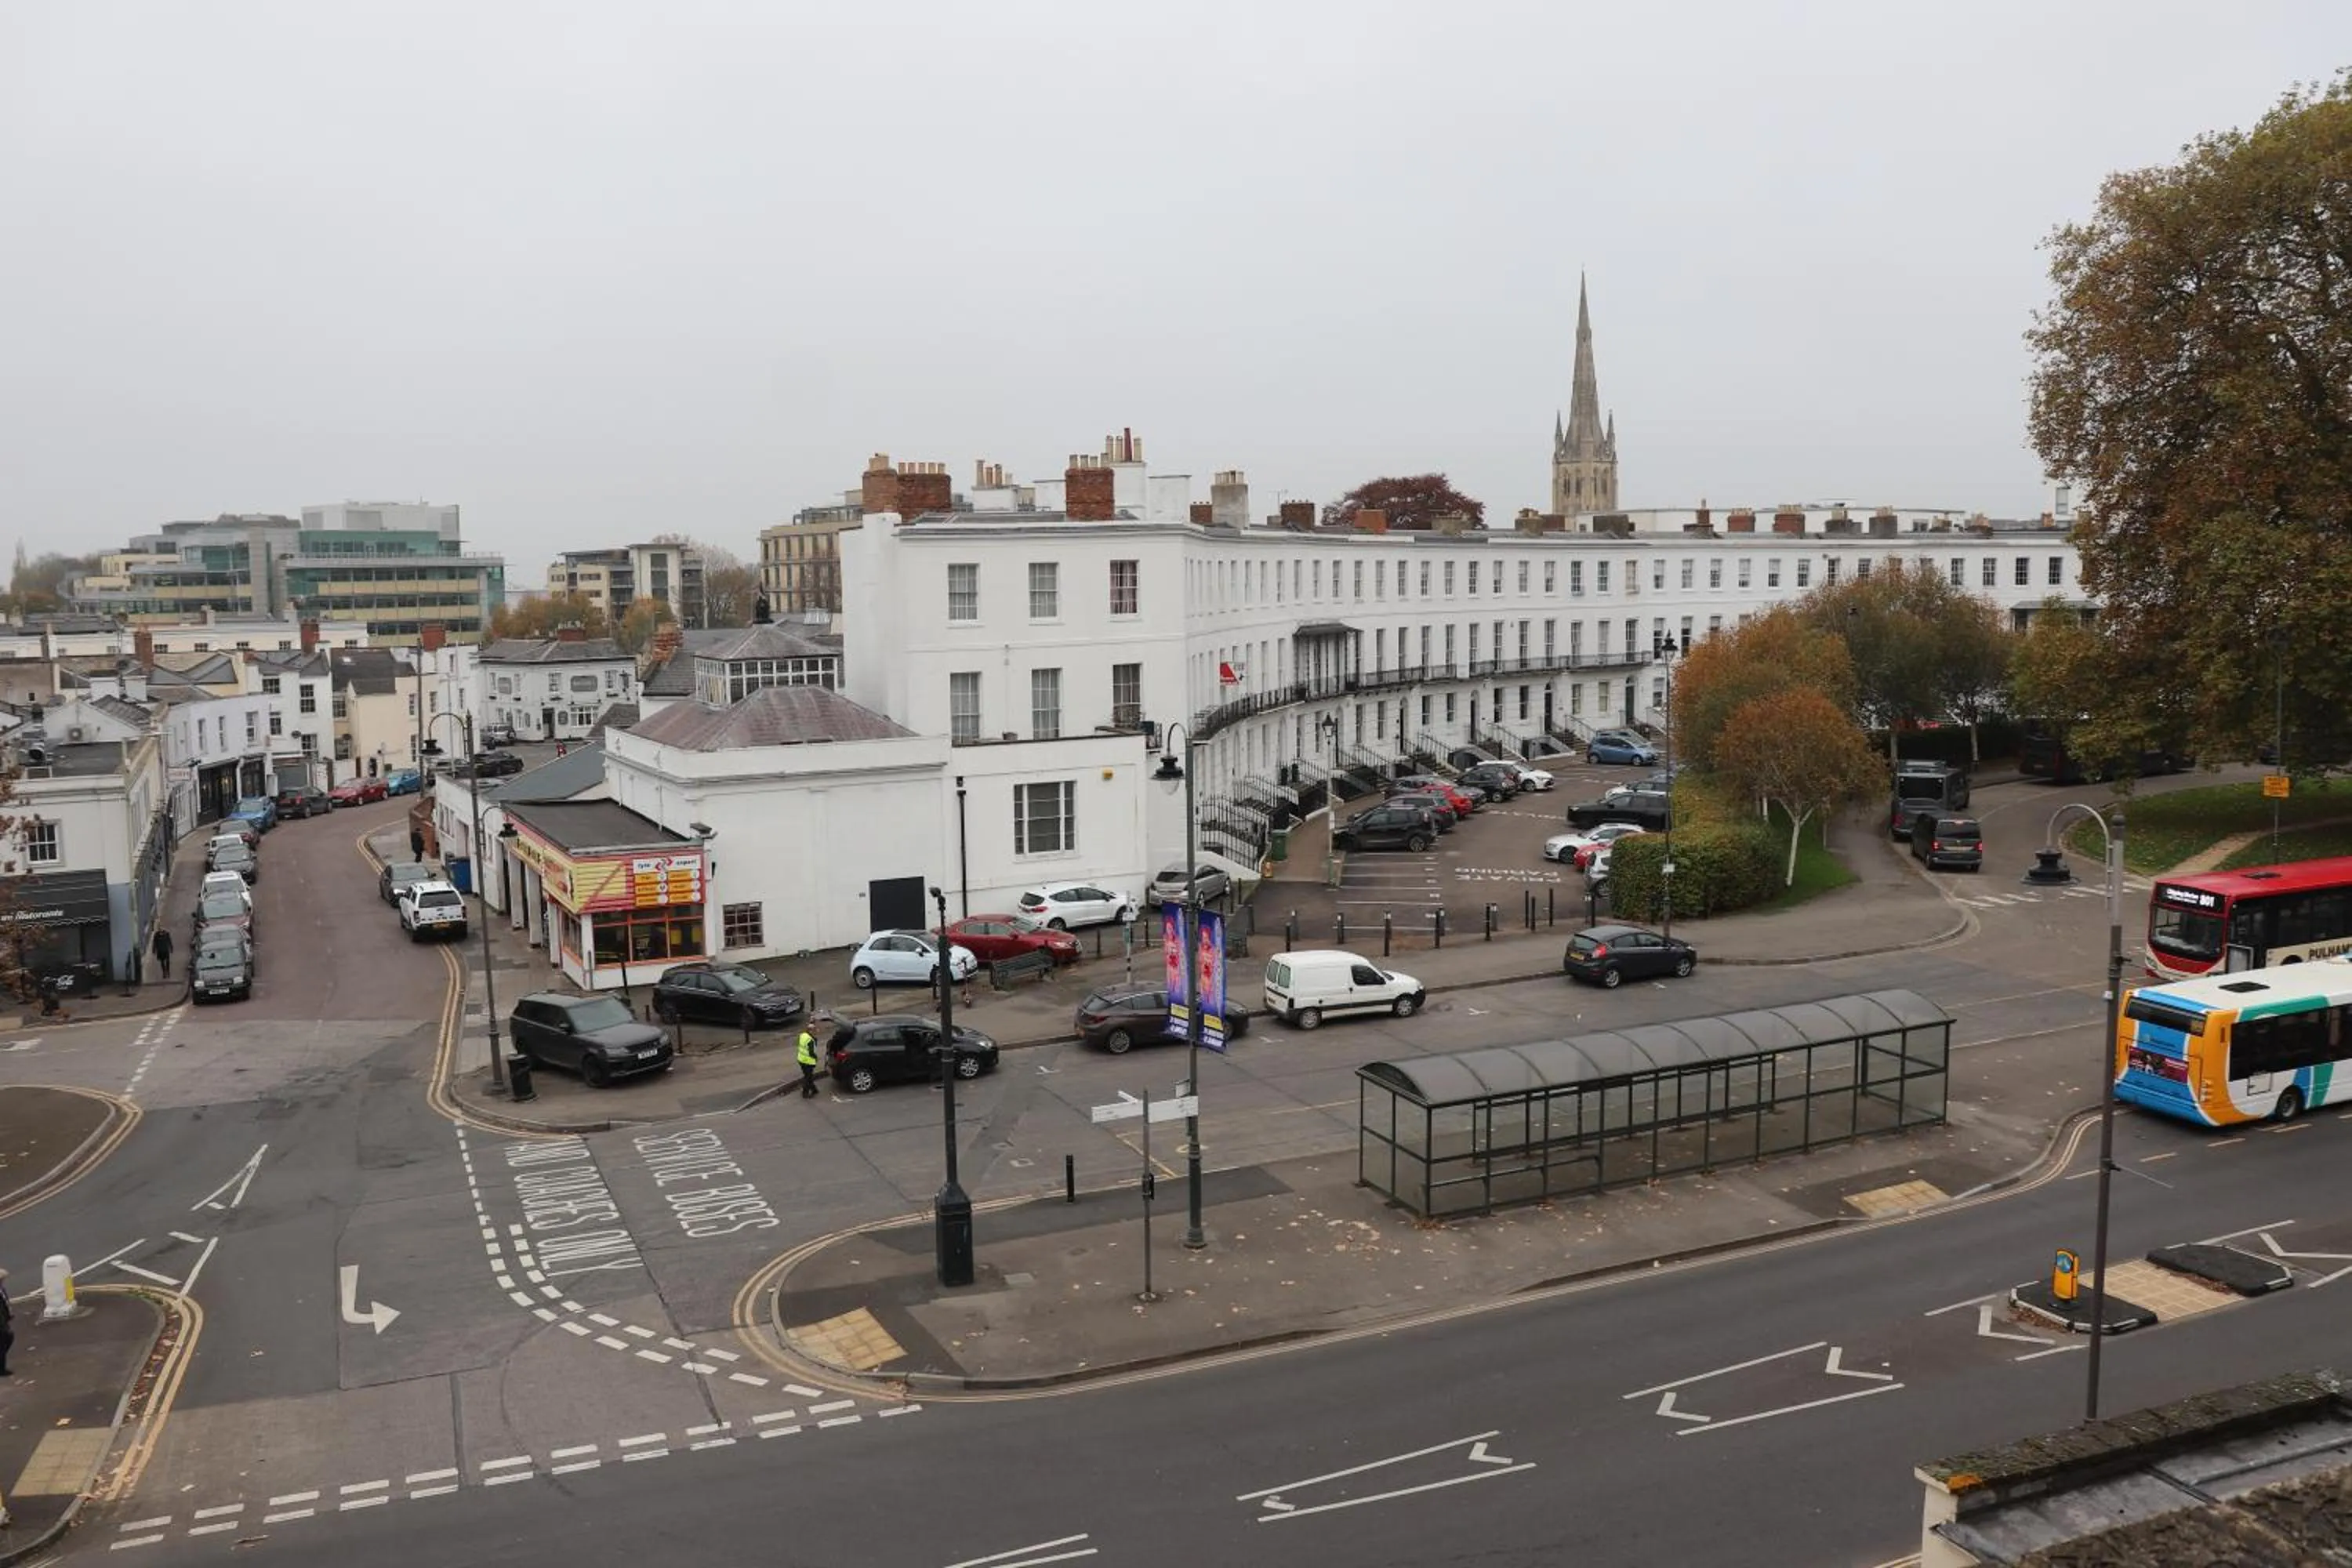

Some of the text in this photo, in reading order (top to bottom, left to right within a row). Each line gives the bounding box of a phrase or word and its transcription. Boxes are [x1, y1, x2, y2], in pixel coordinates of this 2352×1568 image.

[502, 1138, 645, 1277] AND COACHES ONLY
[633, 1128, 781, 1238] SERVICE BUSES
